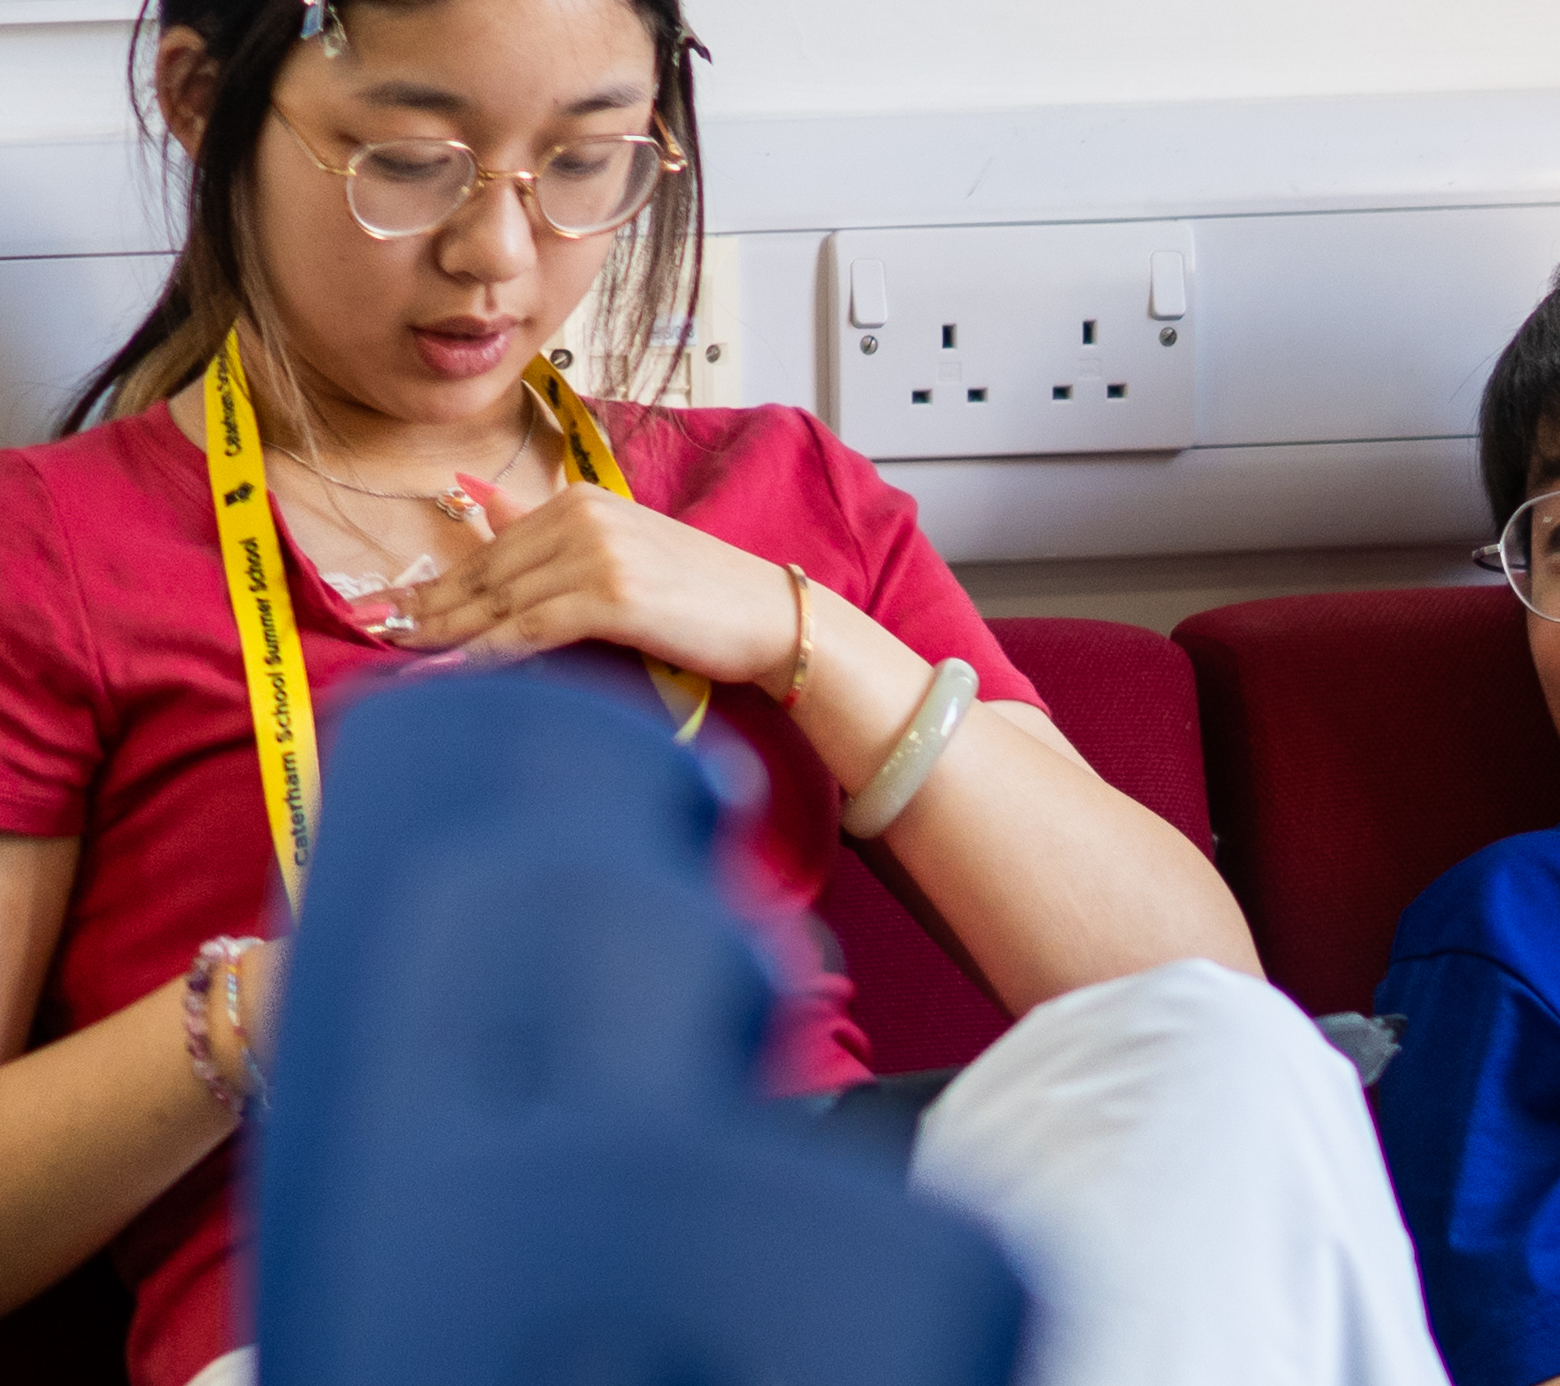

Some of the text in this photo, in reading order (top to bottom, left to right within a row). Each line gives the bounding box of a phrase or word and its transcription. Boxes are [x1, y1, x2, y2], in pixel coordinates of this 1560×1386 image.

[239, 537, 310, 867] Caterham School Summer School
